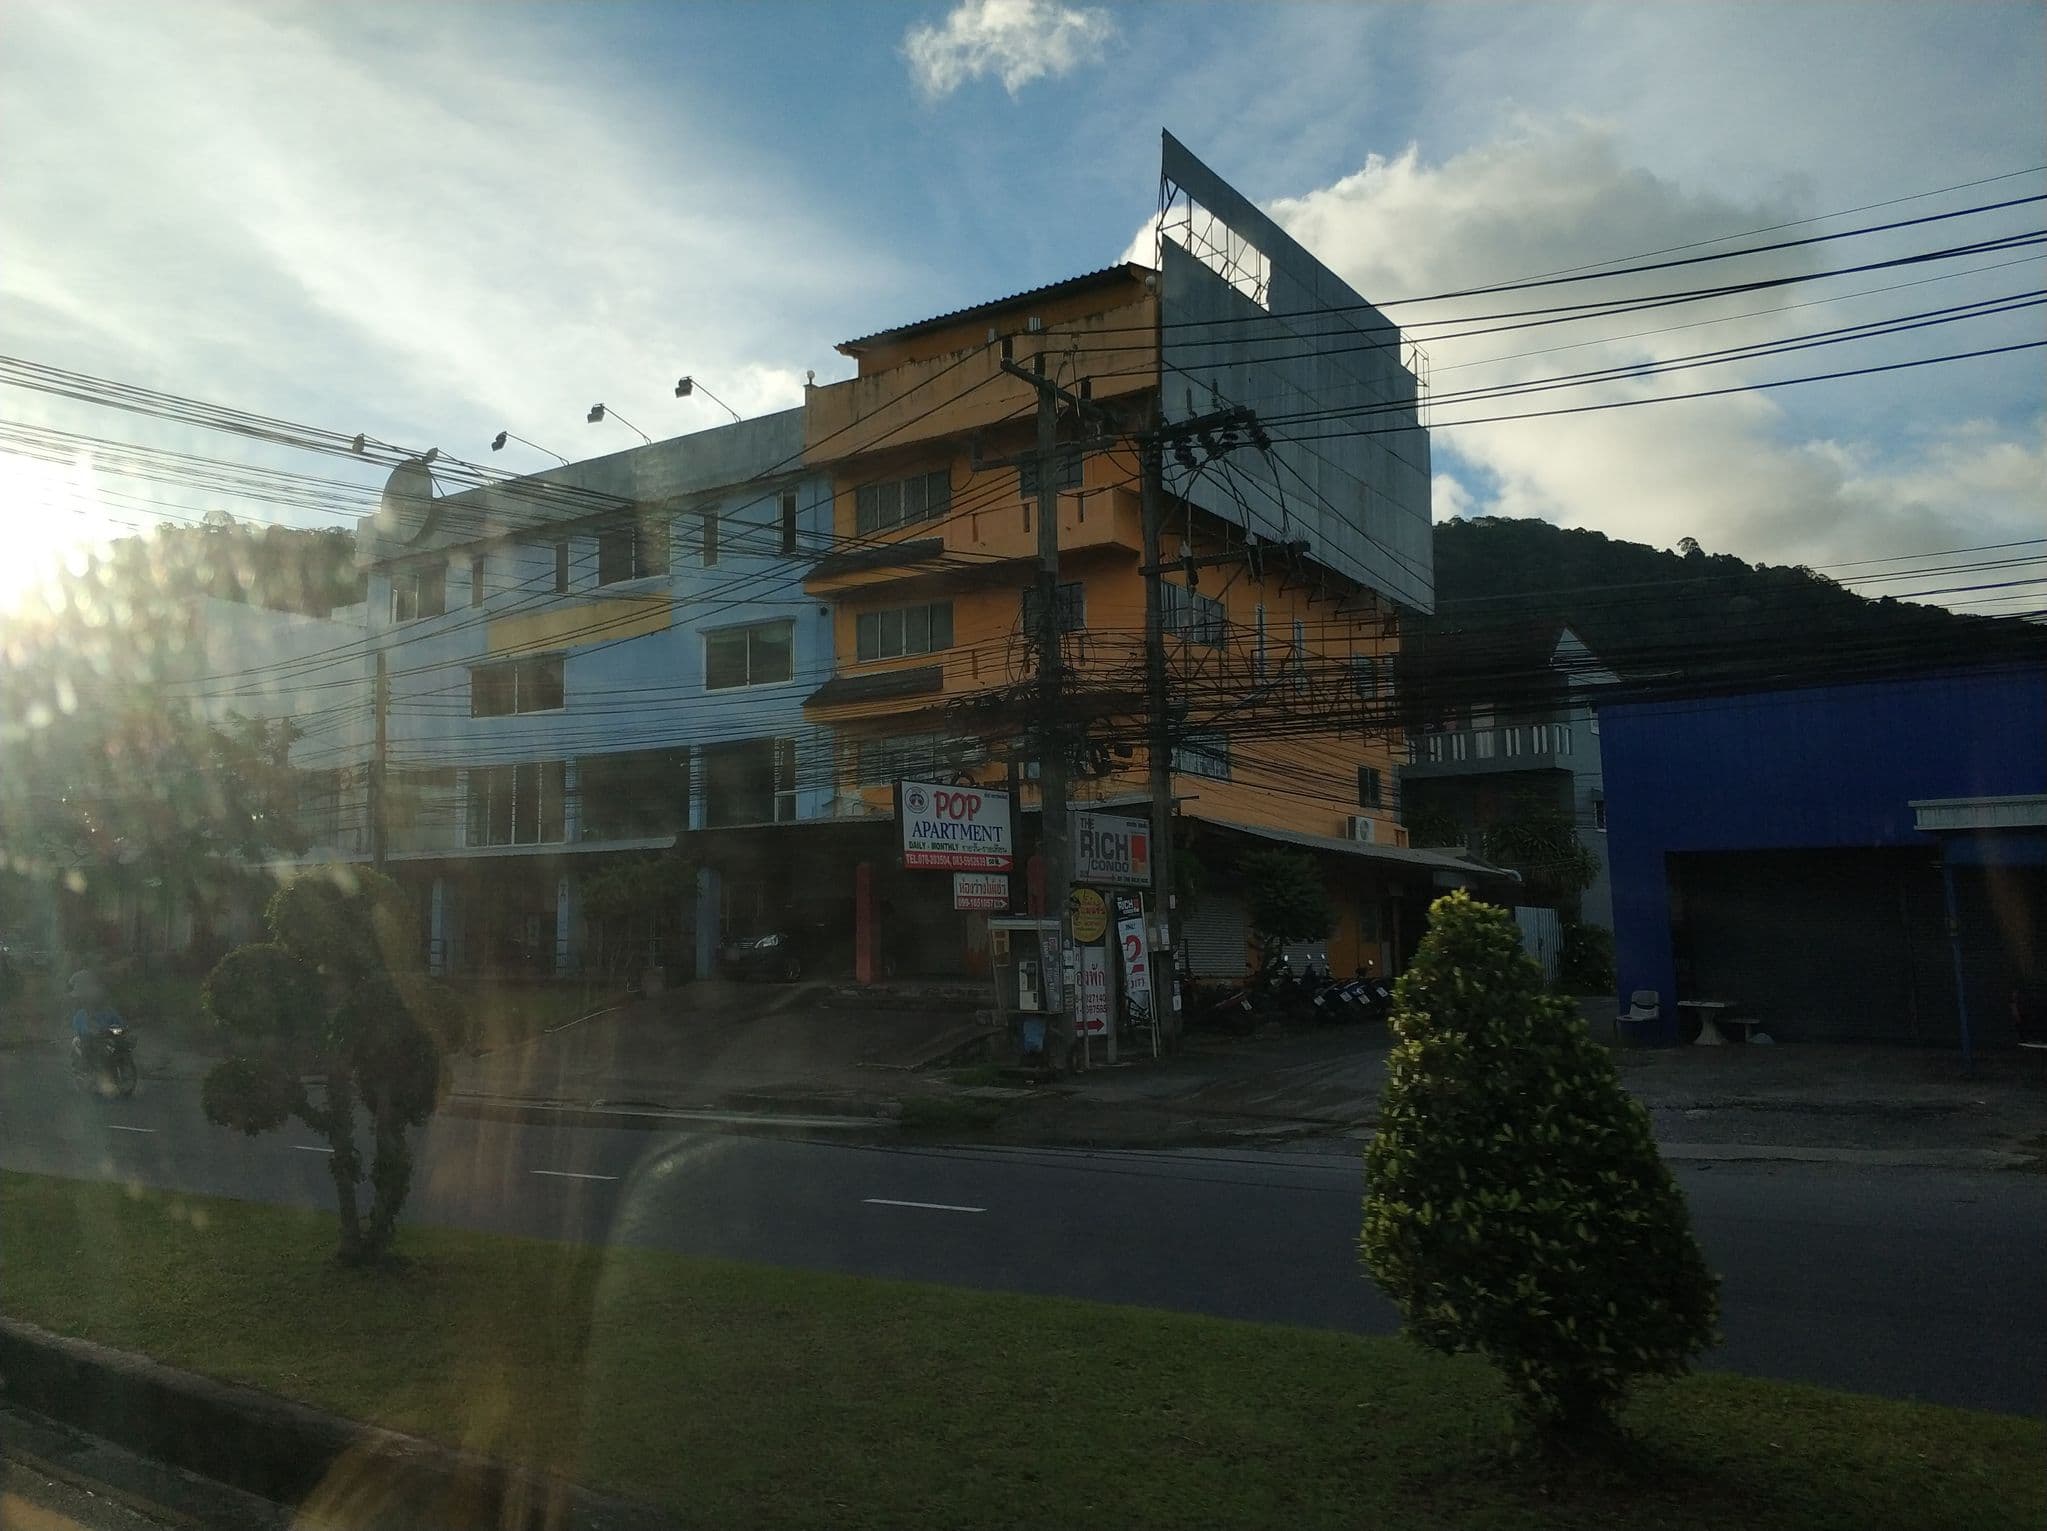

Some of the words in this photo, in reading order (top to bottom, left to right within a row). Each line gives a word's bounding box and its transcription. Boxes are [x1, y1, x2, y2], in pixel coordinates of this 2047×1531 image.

[933, 791, 982, 821] POP
[912, 820, 1003, 842] APARTMENT
[1080, 818, 1094, 829] THE
[909, 841, 926, 850] DAILY
[932, 843, 959, 851] MONTHLY
[1080, 829, 1129, 861] RICH
[1091, 860, 1129, 872] CONDO
